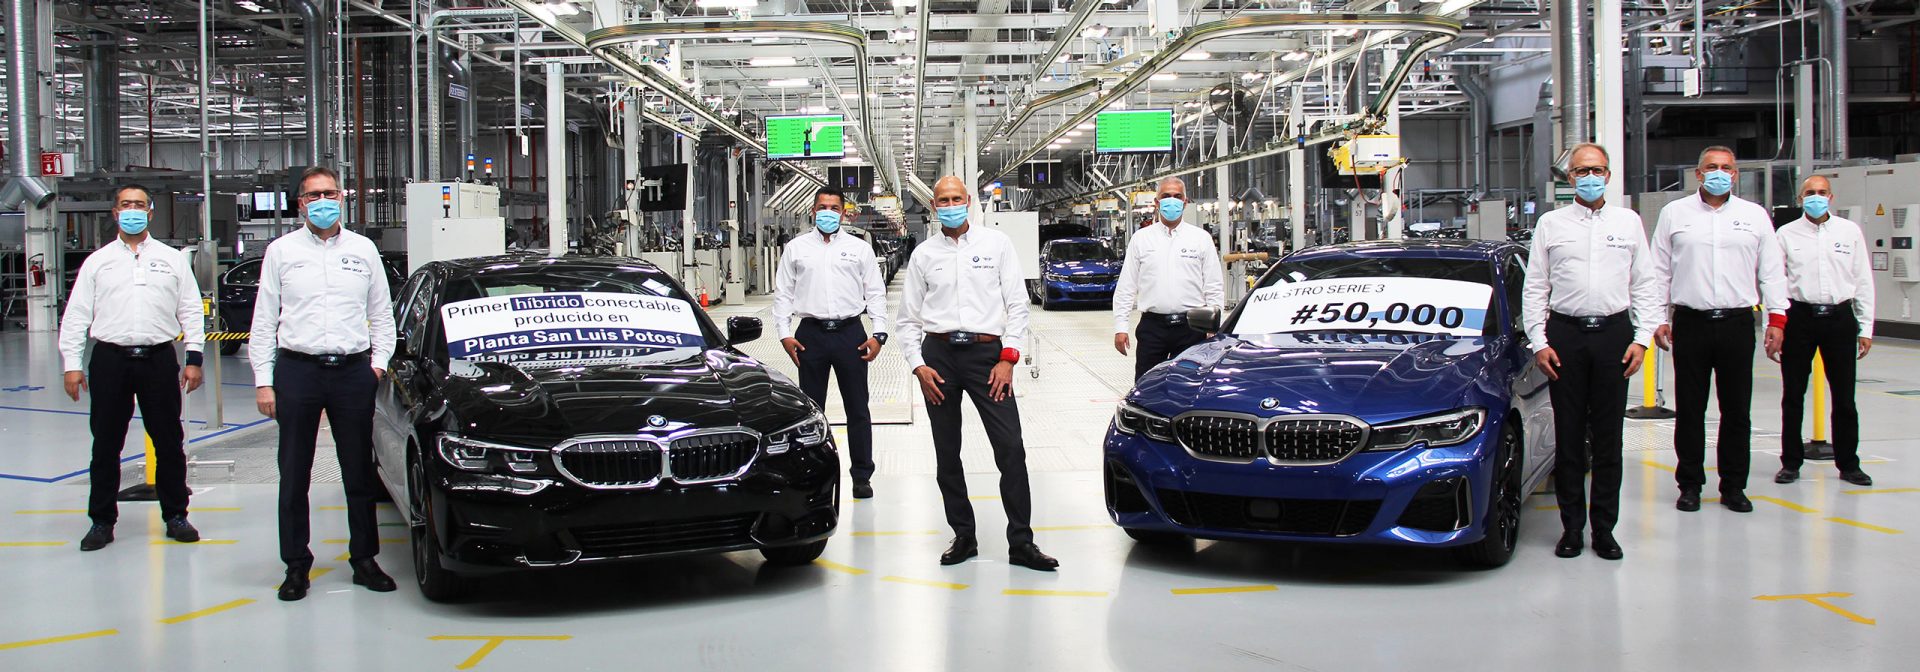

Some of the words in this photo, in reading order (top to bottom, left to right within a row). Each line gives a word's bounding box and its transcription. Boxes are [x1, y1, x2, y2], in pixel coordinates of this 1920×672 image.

[1326, 284, 1369, 294] SERIE
[1374, 284, 1385, 293] 3
[448, 300, 509, 319] Primer
[515, 295, 580, 309] híbrido
[584, 298, 681, 313] conectable
[514, 311, 604, 327] producido
[608, 313, 629, 323] en
[1290, 302, 1464, 329] #50,000
[464, 335, 530, 352] Planta
[534, 330, 572, 343] San
[576, 328, 616, 341] Luis
[619, 330, 683, 345] Potosí
